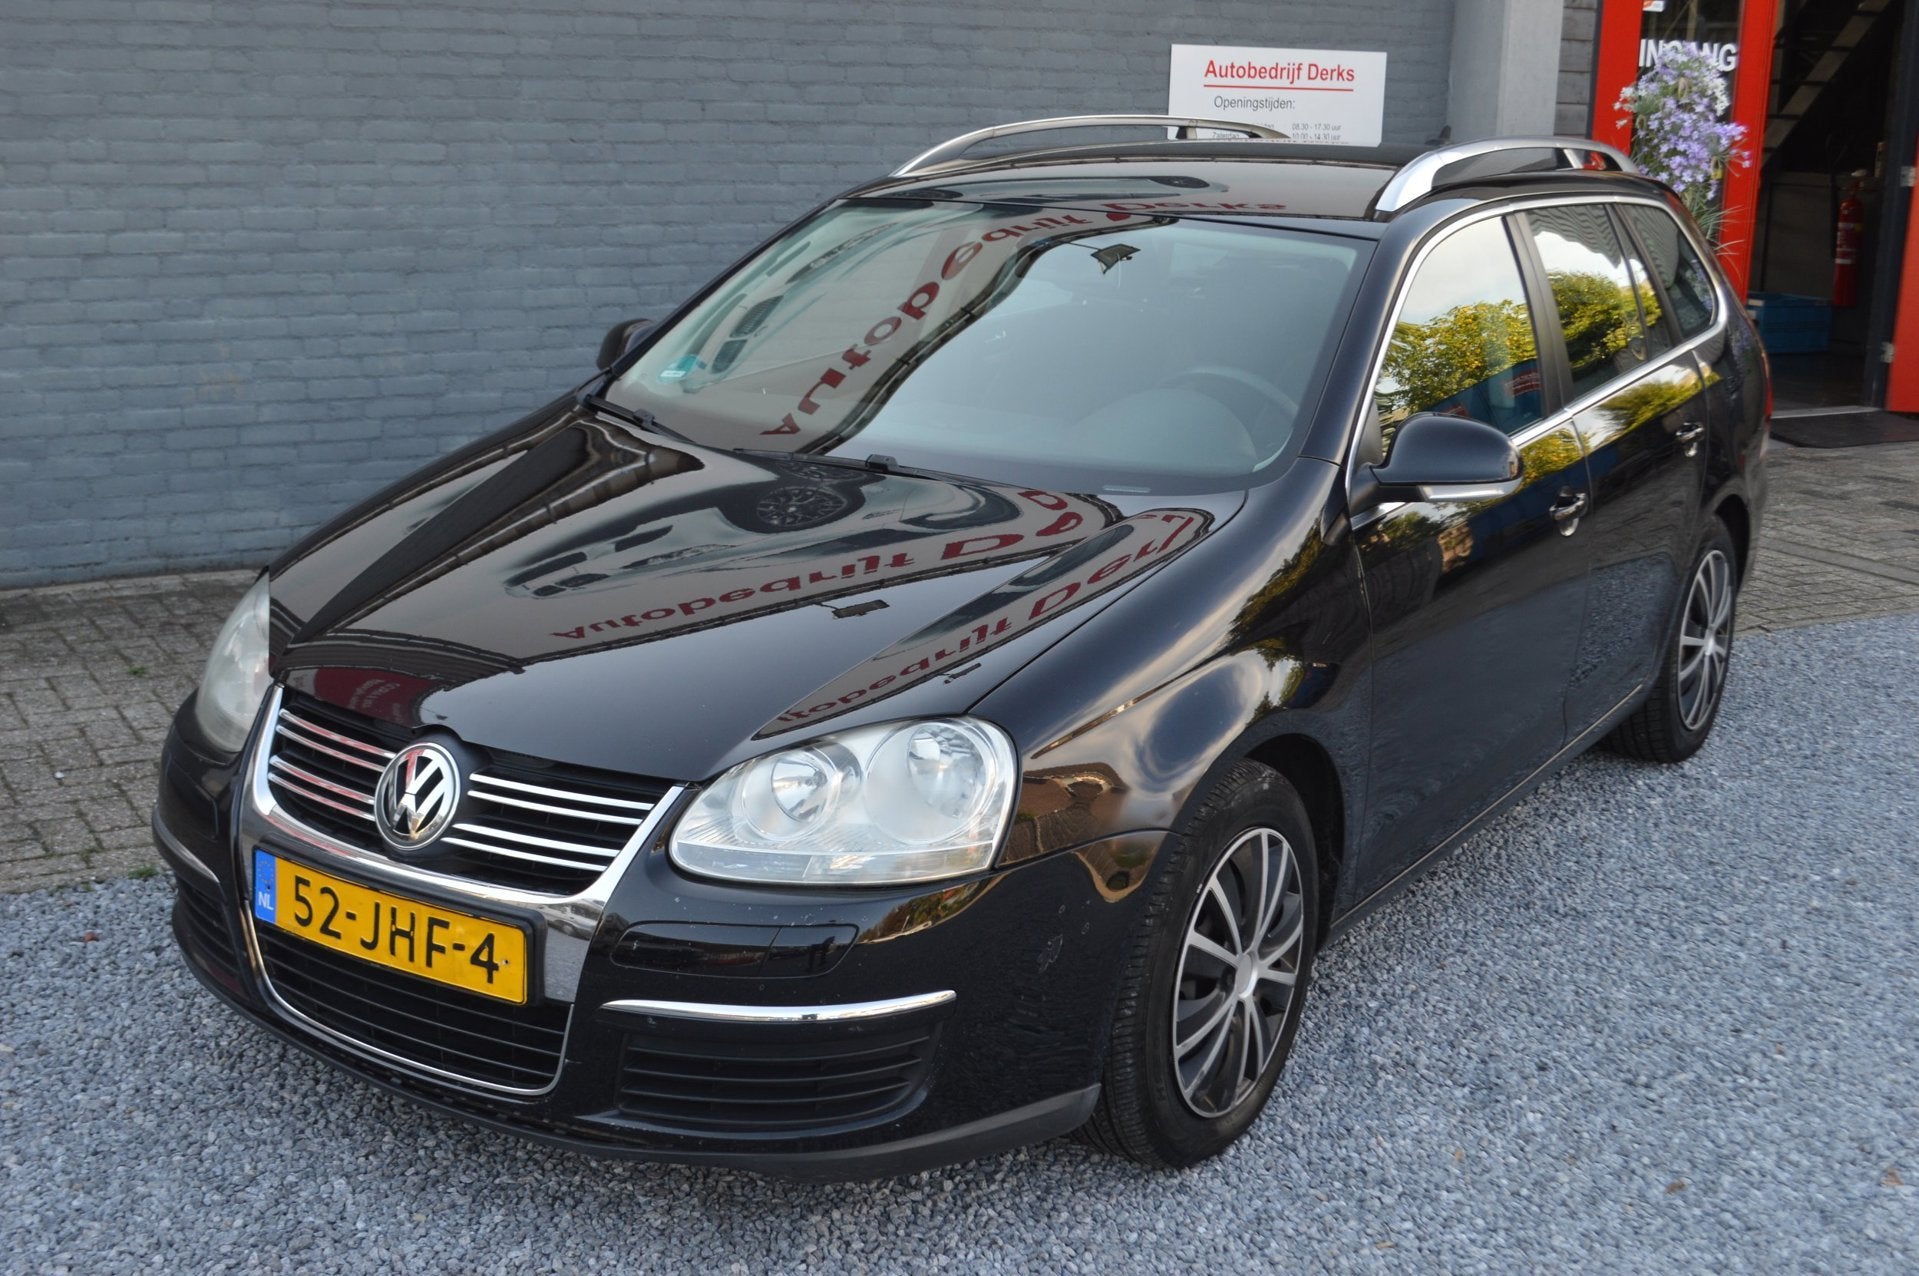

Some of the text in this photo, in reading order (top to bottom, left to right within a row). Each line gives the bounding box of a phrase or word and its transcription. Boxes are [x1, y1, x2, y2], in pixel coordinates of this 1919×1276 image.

[1638, 38, 1737, 71] INNG
[1204, 59, 1355, 84] Autobedrijf Derks
[1213, 95, 1296, 112] Openingstijden:
[257, 888, 275, 912] NL
[293, 873, 501, 985] 52-JHF-4
